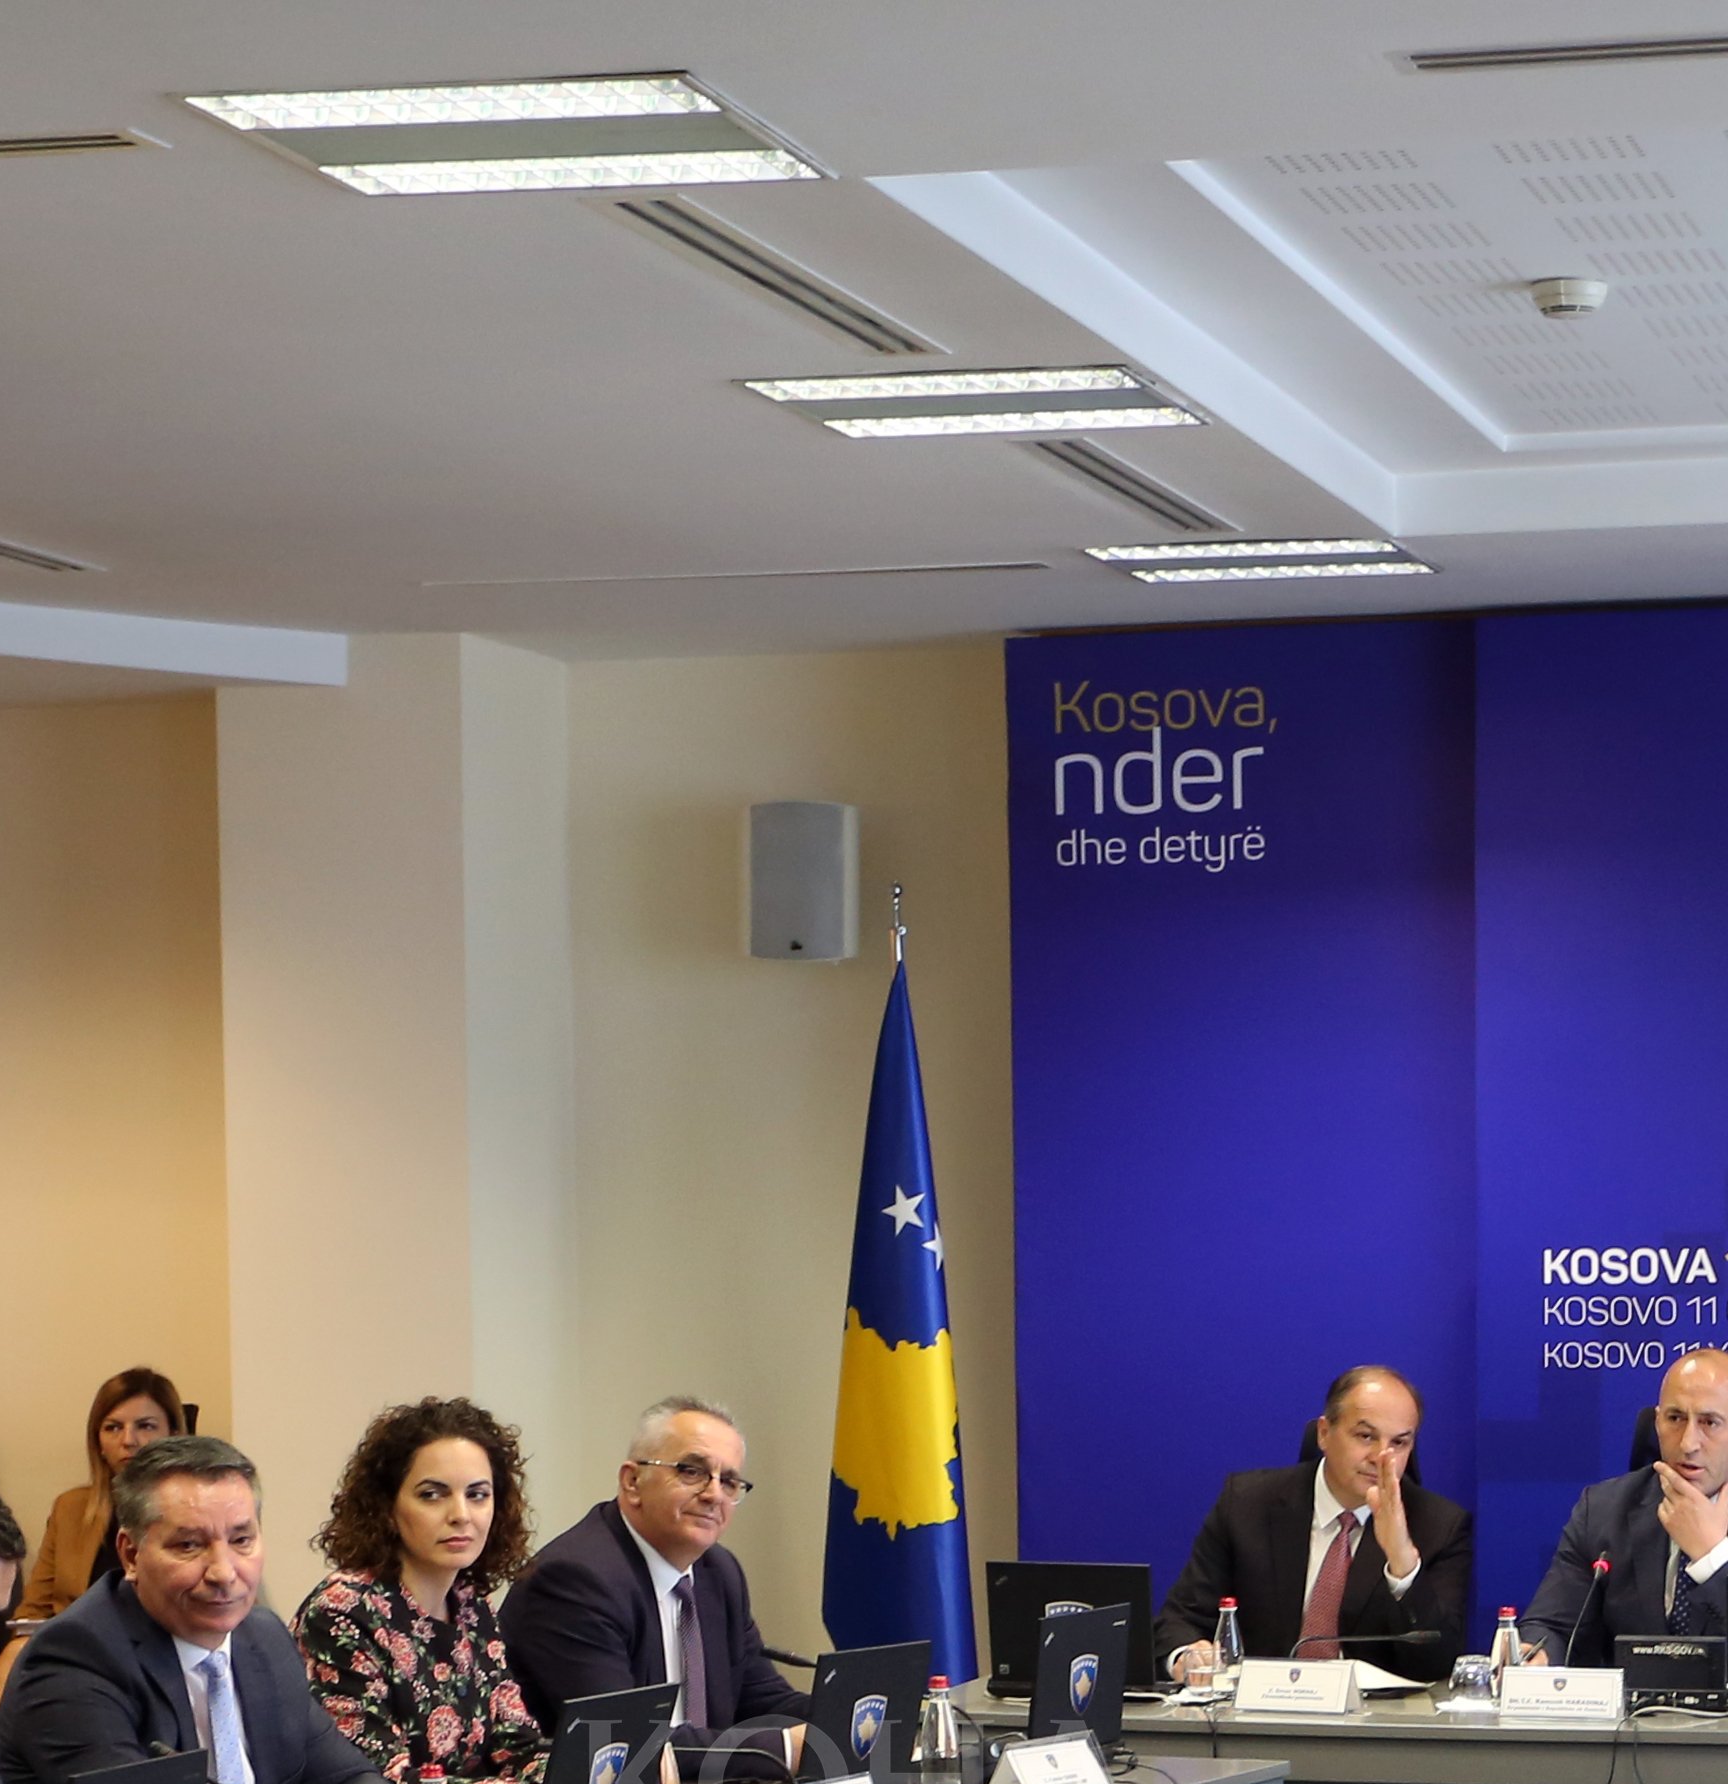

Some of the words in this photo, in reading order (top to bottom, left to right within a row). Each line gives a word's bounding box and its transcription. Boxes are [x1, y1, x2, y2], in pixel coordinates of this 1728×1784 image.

[1054, 681, 1277, 734] Kosova,
[1054, 727, 1264, 815] nder
[1056, 829, 1126, 867] dhe
[1139, 826, 1265, 873] detyrë
[1543, 1247, 1718, 1285] KOSOVA
[1543, 1296, 1677, 1326] KOSOVO
[1686, 1296, 1718, 1325] 11
[1543, 1341, 1665, 1369] KOSOVO
